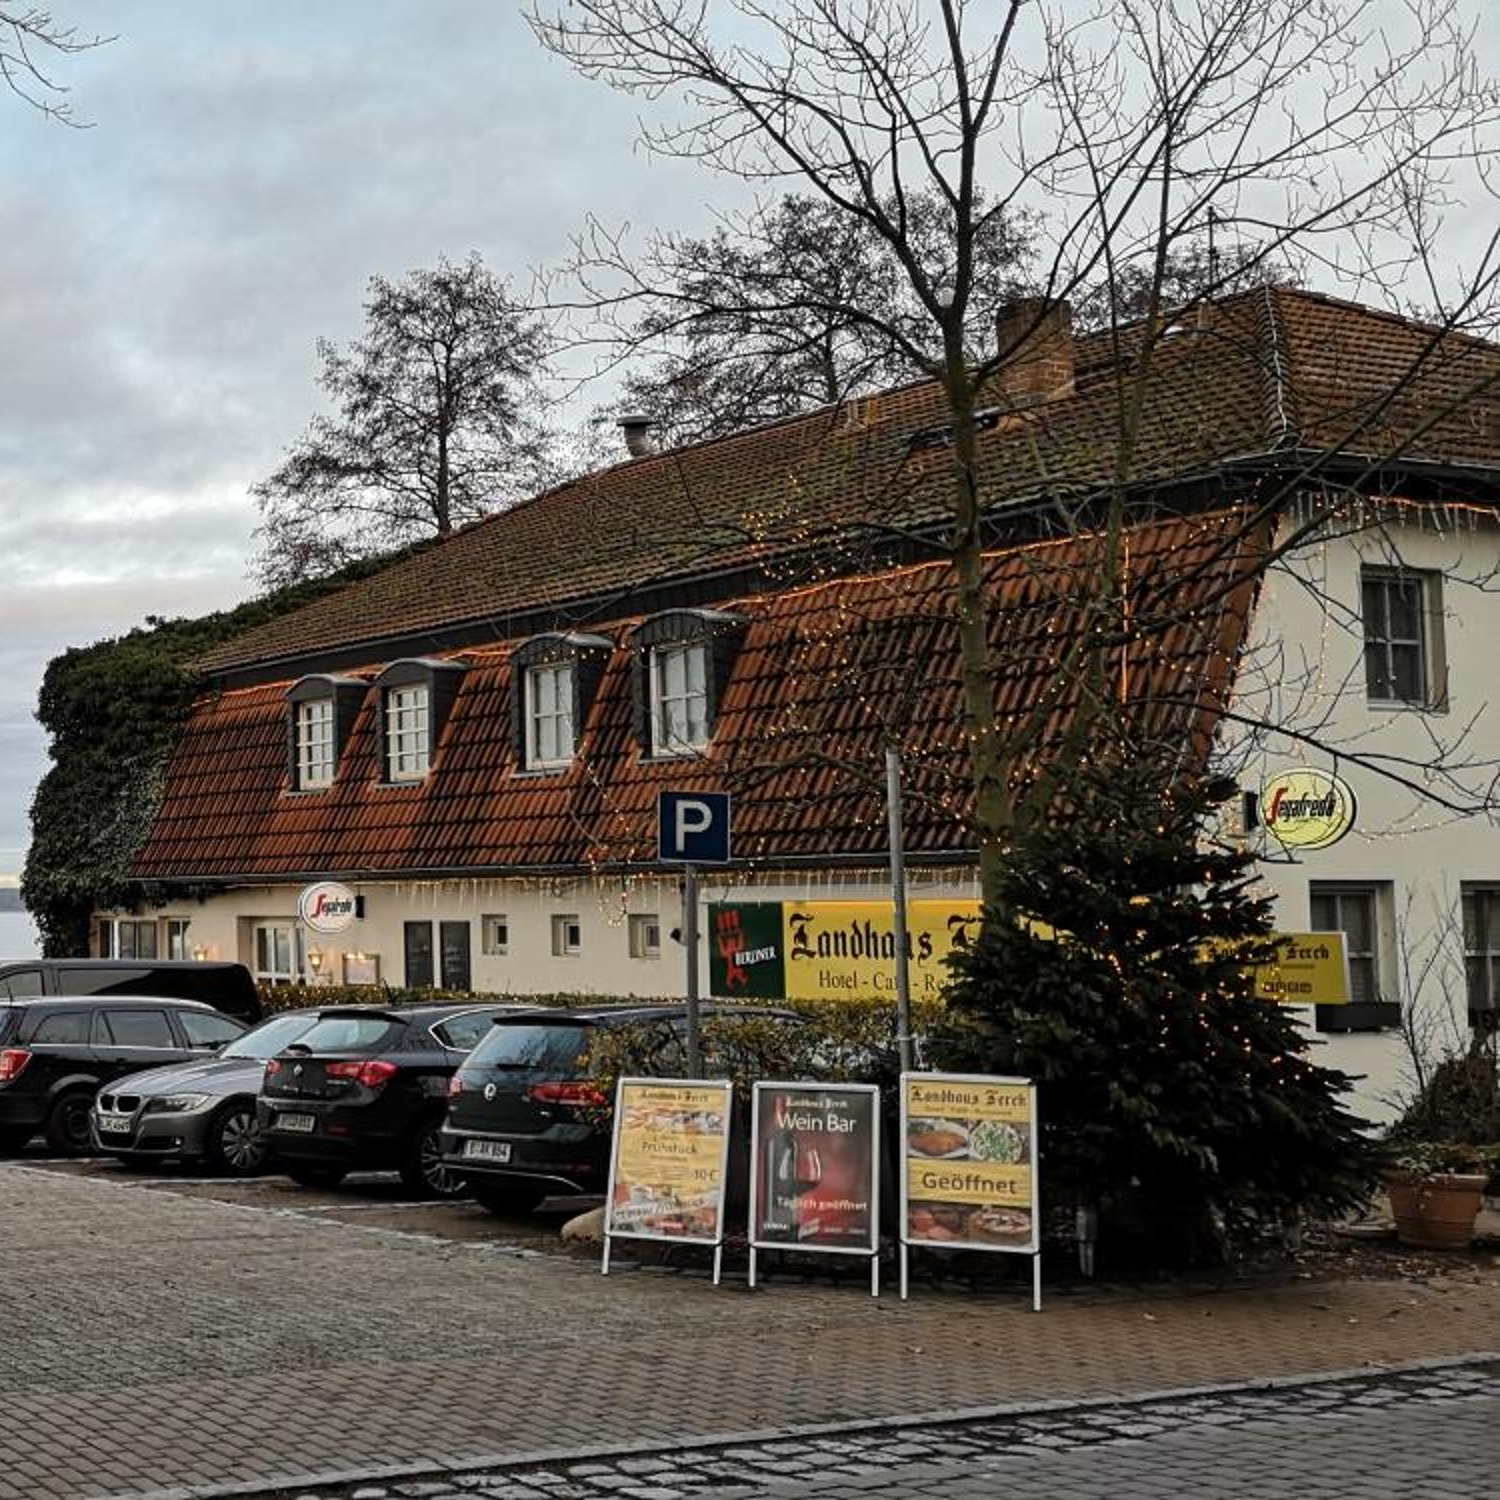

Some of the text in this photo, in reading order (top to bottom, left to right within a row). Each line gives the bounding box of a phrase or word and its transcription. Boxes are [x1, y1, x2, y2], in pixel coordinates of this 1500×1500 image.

[675, 799, 713, 852] P
[819, 969, 858, 989] Hotel
[777, 1111, 857, 1133] Wein Bar
[921, 1171, 1017, 1195] Geöffnet
